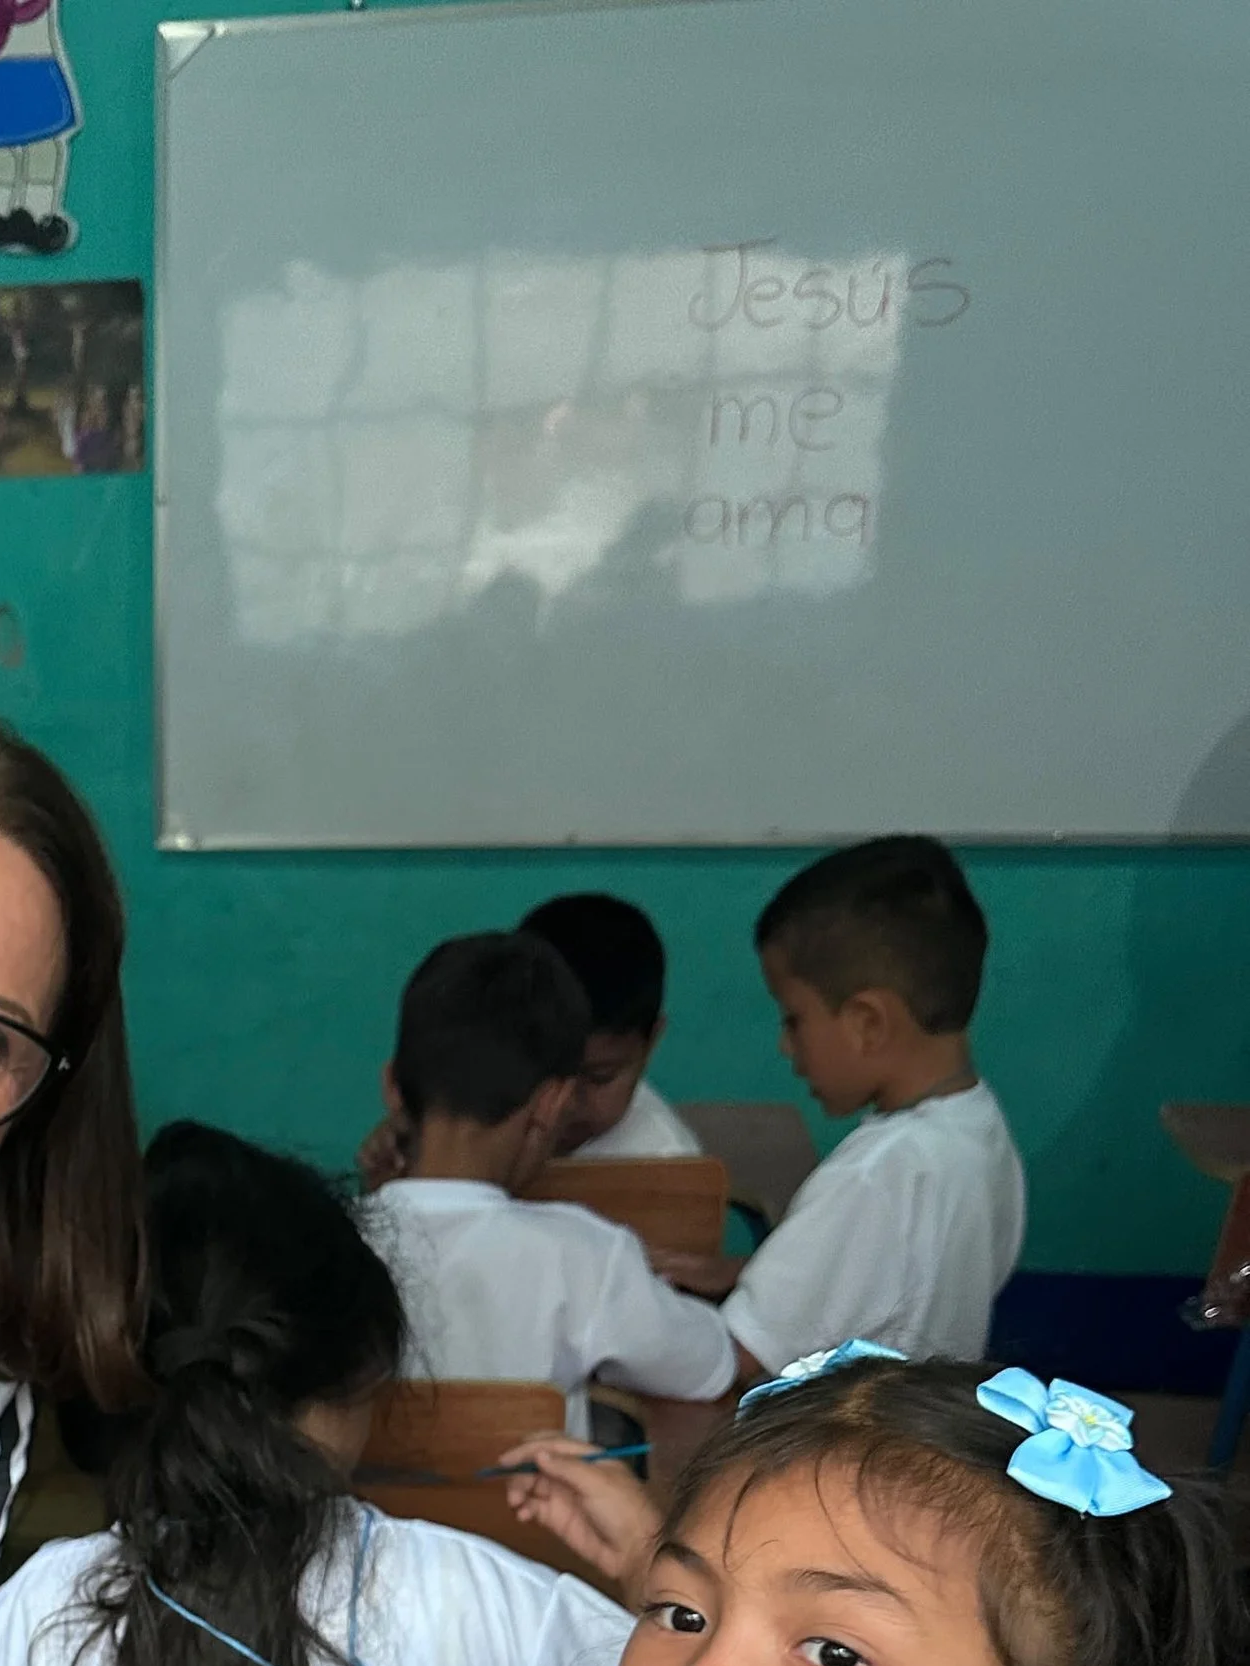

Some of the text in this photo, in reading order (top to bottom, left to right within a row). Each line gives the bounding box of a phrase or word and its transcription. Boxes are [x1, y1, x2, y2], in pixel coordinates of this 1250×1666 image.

[688, 236, 971, 332] Jesús
[710, 387, 844, 452] me
[685, 492, 873, 547] ama
